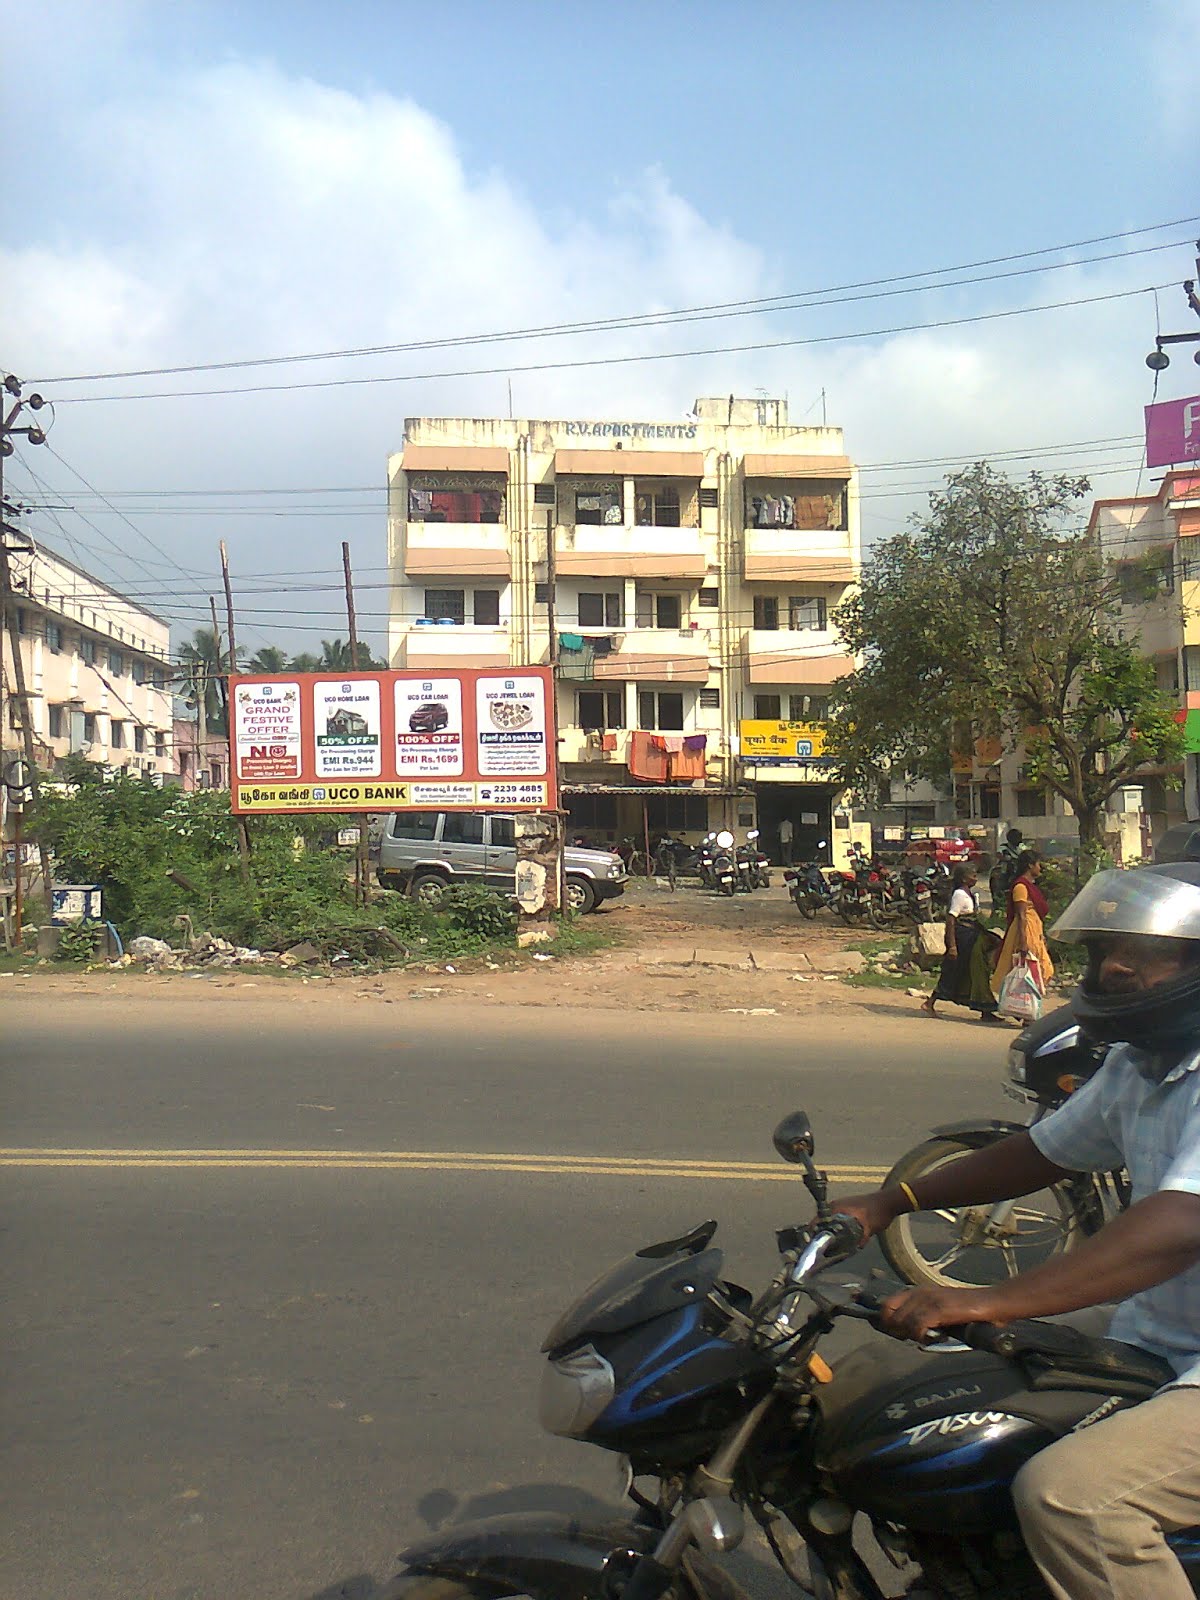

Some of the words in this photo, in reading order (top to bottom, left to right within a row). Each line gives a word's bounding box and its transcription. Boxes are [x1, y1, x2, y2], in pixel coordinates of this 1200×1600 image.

[592, 422, 698, 438] APARTMENTS
[246, 706, 290, 714] GRAND
[243, 716, 294, 724] FESTIVE
[248, 726, 289, 734] OFFER
[321, 737, 345, 745] 50%
[399, 736, 429, 744] 100%
[323, 757, 340, 765] EMI
[343, 756, 374, 764] Rs.944
[401, 756, 418, 764] EMI
[421, 755, 459, 763] Rs.1699
[328, 788, 360, 799] UCO
[364, 787, 406, 799] BANK
[914, 1384, 982, 1408] BAJAJ
